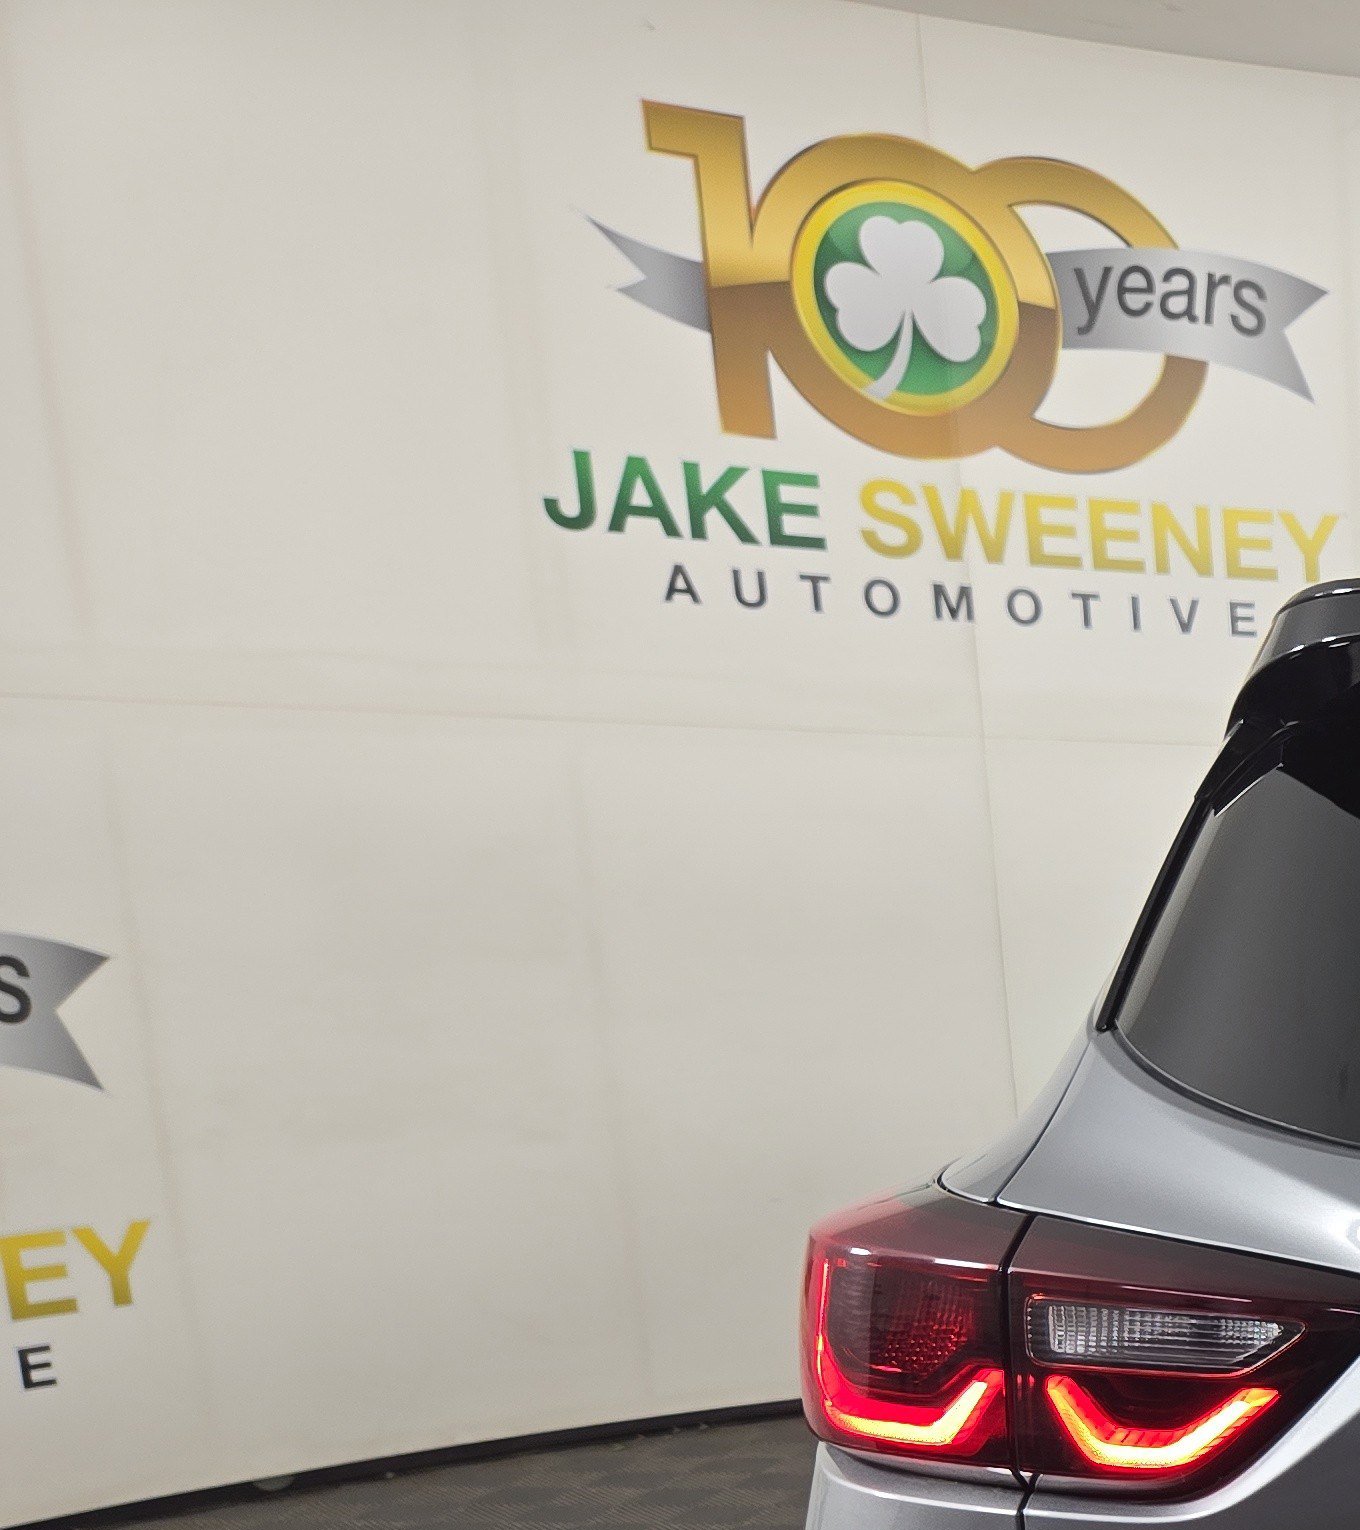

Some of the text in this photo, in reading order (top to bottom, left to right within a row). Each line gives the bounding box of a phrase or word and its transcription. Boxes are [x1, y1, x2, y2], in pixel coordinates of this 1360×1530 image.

[640, 98, 1268, 475] 100 years
[542, 448, 1342, 584] JAKE SWEENEY
[663, 562, 1258, 638] AUTOMOTIVE
